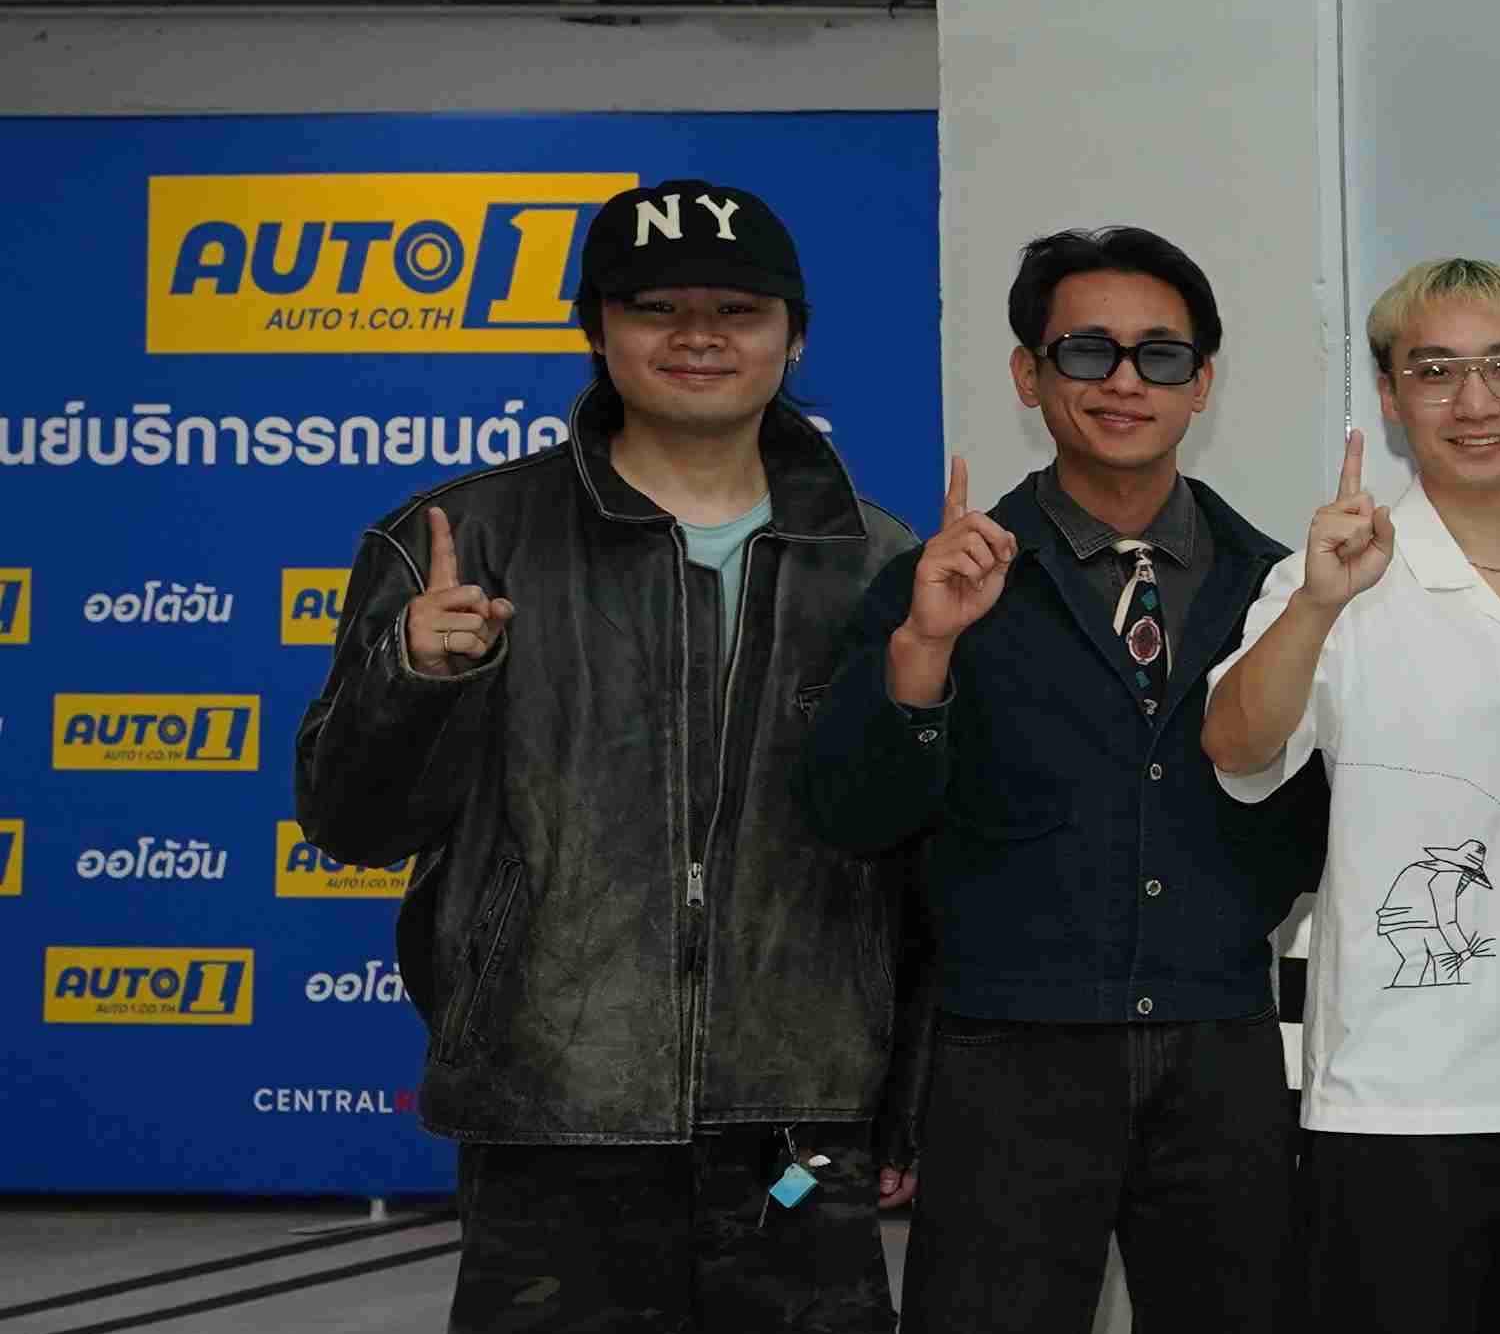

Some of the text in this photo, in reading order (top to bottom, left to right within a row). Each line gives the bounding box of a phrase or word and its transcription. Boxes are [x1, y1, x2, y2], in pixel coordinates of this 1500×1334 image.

[84, 581, 234, 623] ออโต้วัน
[76, 837, 228, 879] ออโต้วัน
[253, 1087, 393, 1114] CENTRAL
